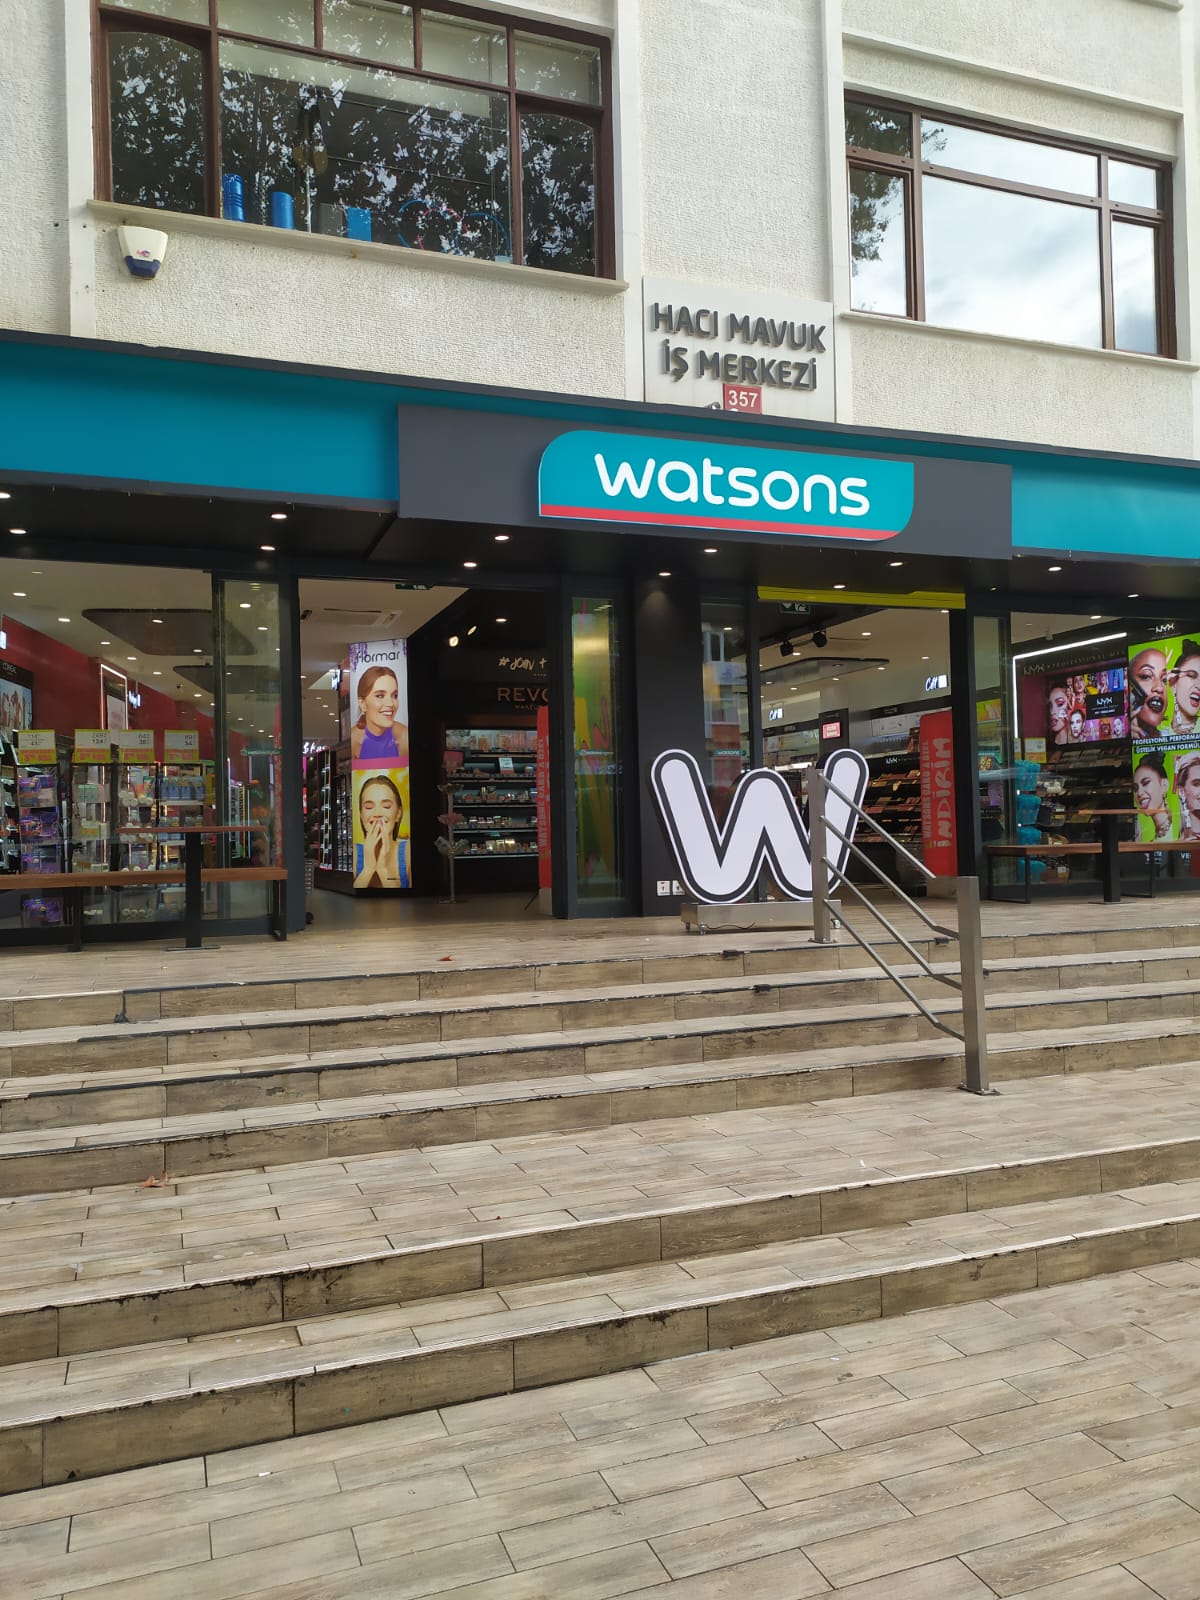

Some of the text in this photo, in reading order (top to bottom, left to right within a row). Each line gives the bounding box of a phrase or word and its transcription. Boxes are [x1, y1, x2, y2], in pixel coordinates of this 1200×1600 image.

[651, 302, 827, 352] HACI MAVUK
[663, 339, 818, 392] İŞ MERKEZİ
[728, 390, 759, 408] 357
[593, 453, 870, 517] watsons
[356, 650, 401, 663] flormar
